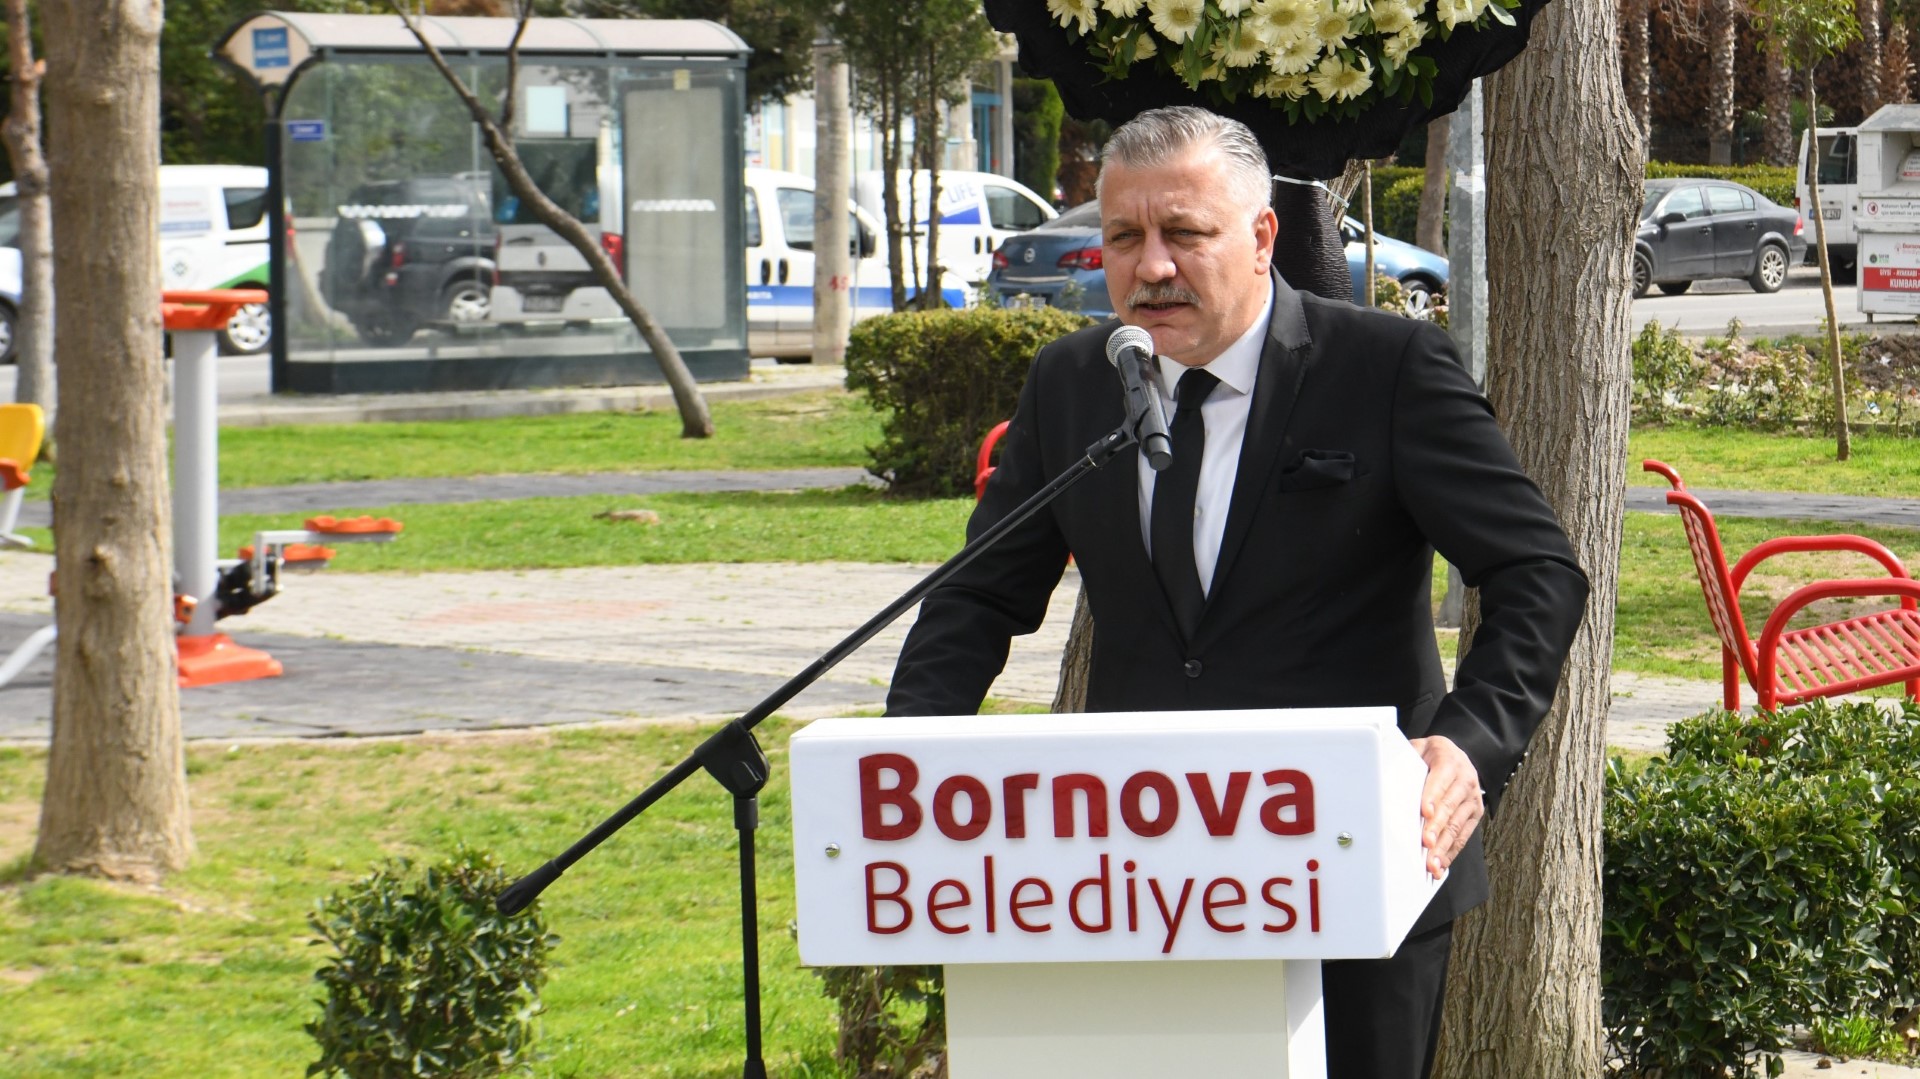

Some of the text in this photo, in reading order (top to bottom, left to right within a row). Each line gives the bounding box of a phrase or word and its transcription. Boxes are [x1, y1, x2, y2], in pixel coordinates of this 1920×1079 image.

[947, 182, 977, 203] LIFE
[859, 753, 1315, 841] Bornova
[865, 853, 1320, 953] Belediyesi
